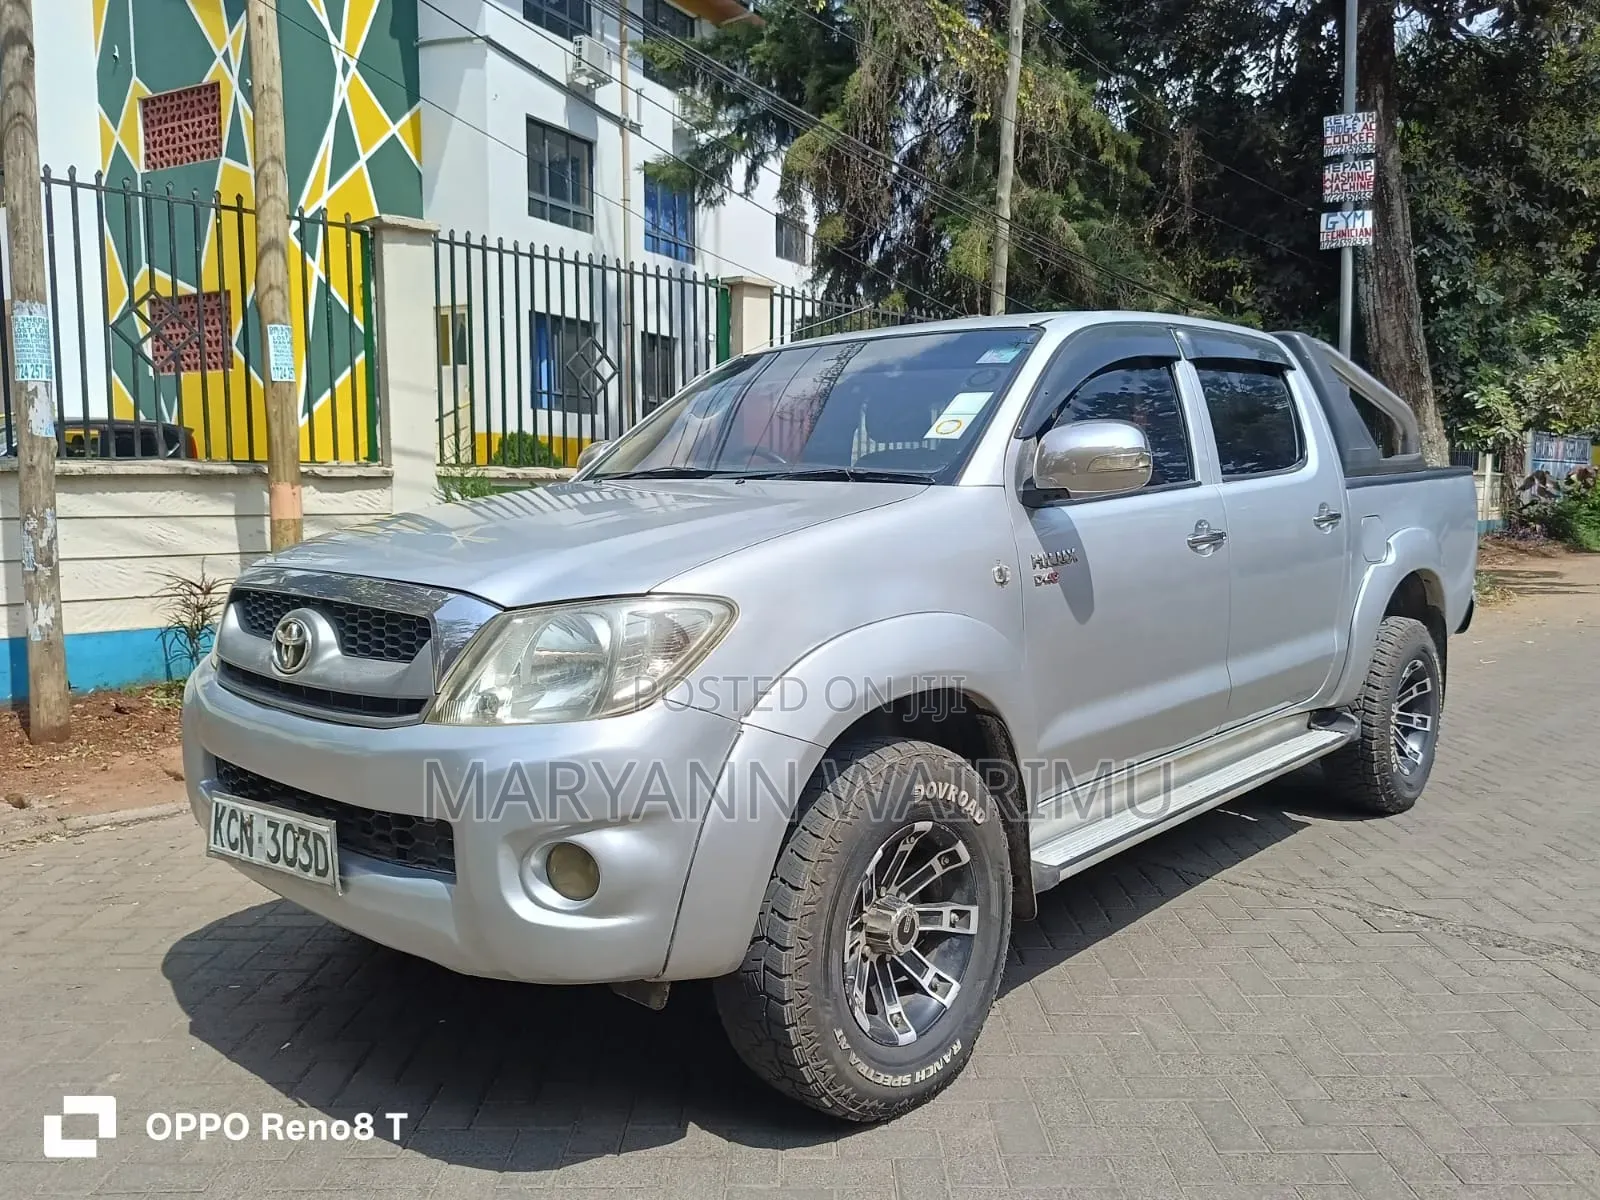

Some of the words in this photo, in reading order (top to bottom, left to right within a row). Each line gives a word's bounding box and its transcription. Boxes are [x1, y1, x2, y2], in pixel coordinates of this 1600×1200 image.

[1325, 113, 1374, 126] REPAIR
[1325, 123, 1358, 136] FRIDGE
[1324, 132, 1375, 146] COOKER
[1323, 160, 1373, 174] REPAIR
[1323, 171, 1374, 184] WASHING
[1323, 181, 1374, 194] MACHINE
[1326, 210, 1365, 231] GYM
[1030, 548, 1078, 570] HILUX
[213, 802, 254, 857] KCN
[266, 819, 330, 878] 303D
[914, 1037, 962, 1083] RANCH
[848, 1049, 912, 1088] SPECTRA
